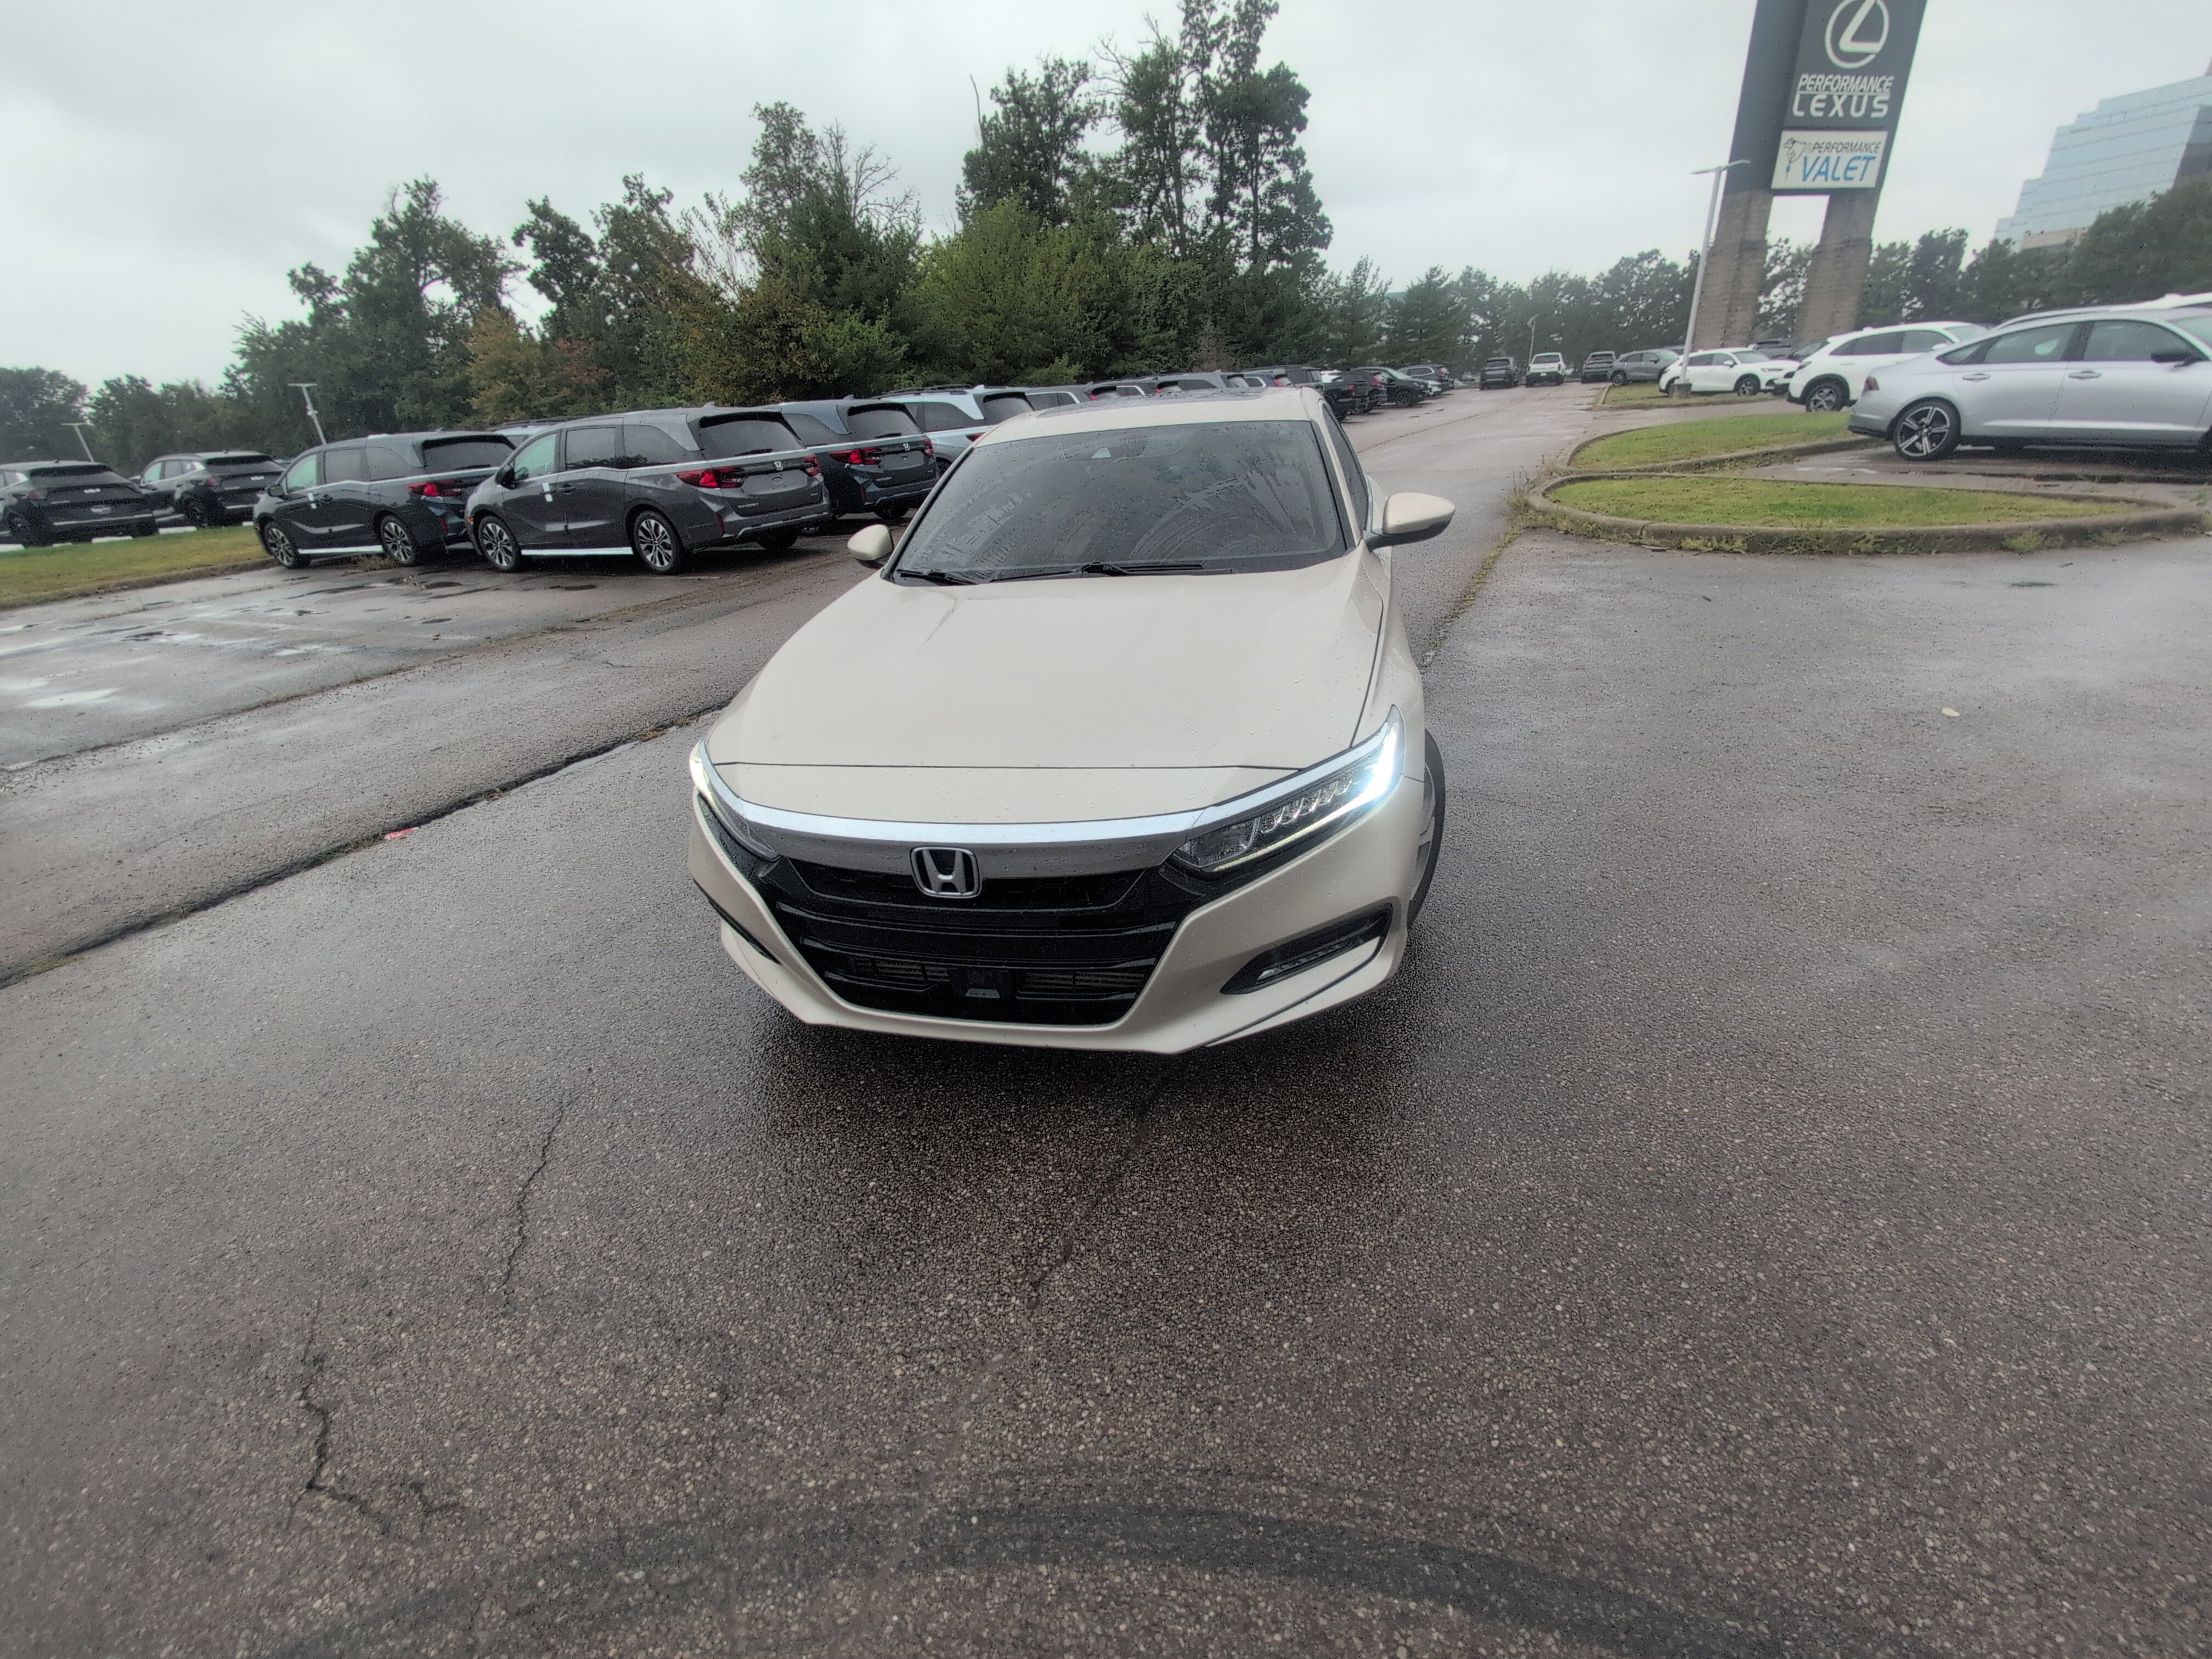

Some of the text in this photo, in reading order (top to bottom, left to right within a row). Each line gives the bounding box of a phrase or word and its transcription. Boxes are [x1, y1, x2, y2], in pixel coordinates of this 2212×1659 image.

[1797, 74, 1895, 94] PERFORMANCE
[1792, 93, 1891, 118] LEXUS
[1812, 141, 1882, 154] PERFORMANCE
[1802, 155, 1876, 182] VALET
